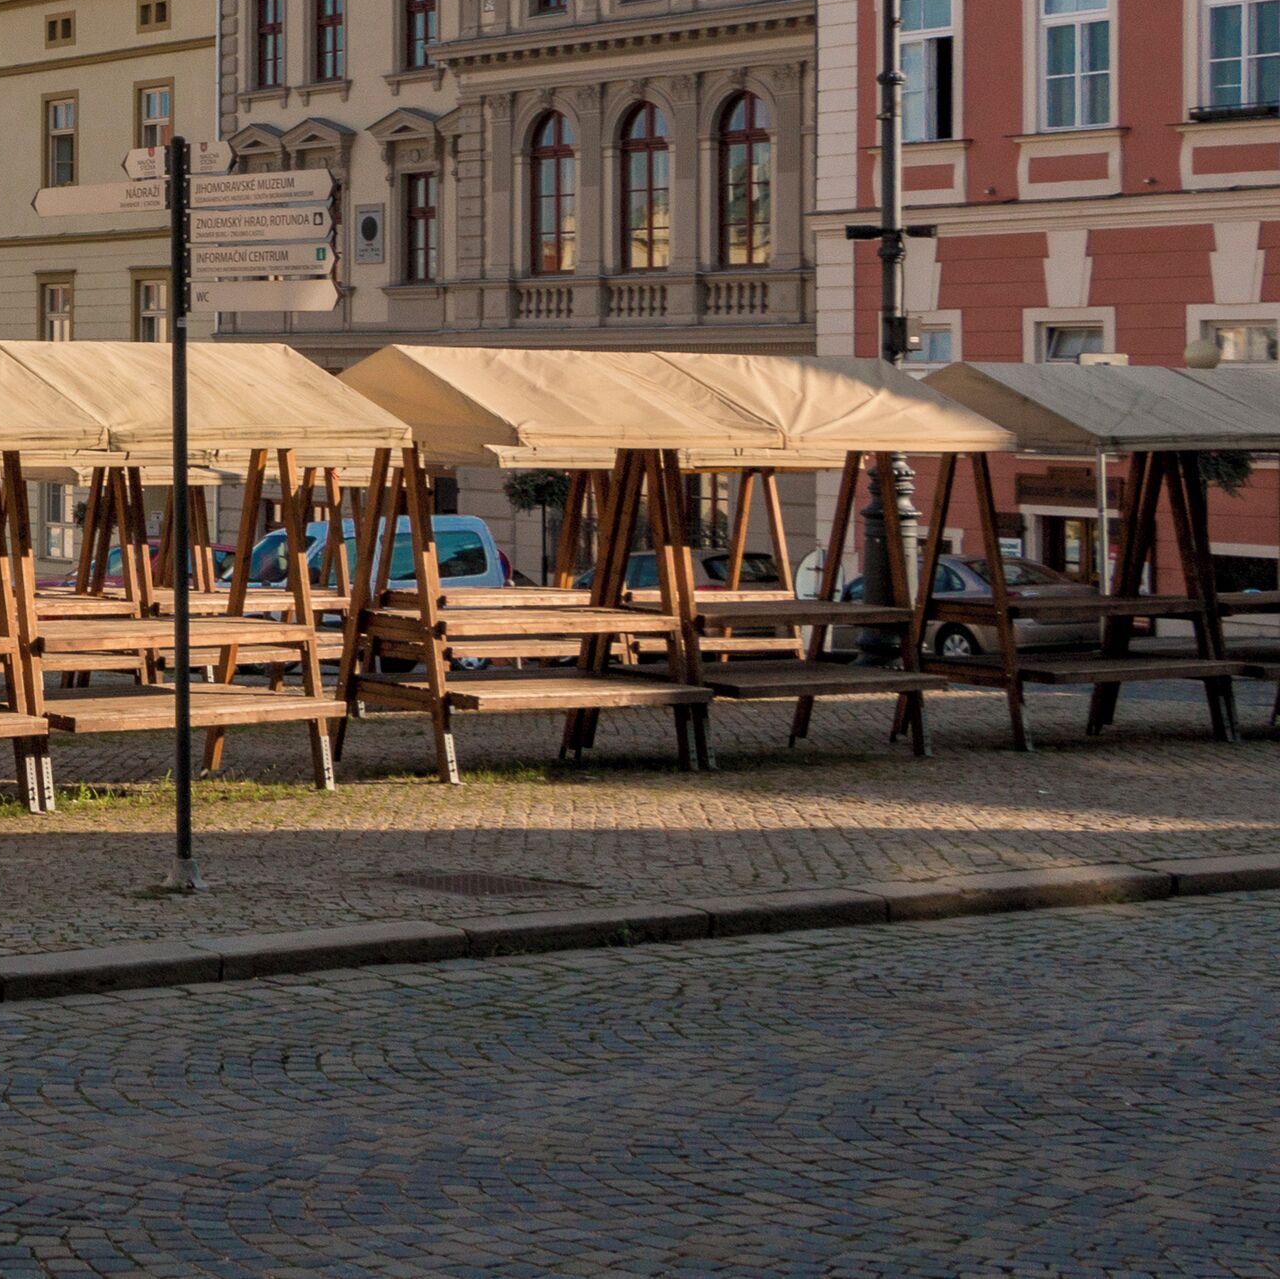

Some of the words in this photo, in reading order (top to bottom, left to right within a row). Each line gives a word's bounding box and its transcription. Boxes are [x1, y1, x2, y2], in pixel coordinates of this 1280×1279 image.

[125, 184, 160, 199] NÁDRAŽÍ
[194, 179, 256, 195] JIHOMORAVSKÉ
[257, 177, 295, 190] MUZEUM
[195, 214, 242, 230] ZNOJEMSKÝ
[244, 216, 269, 228] HRAD,
[270, 214, 310, 226] ROTUNDA
[196, 250, 247, 263] INFORMAČNÍ
[248, 250, 289, 262] CENTRUM
[196, 291, 209, 302] WC
